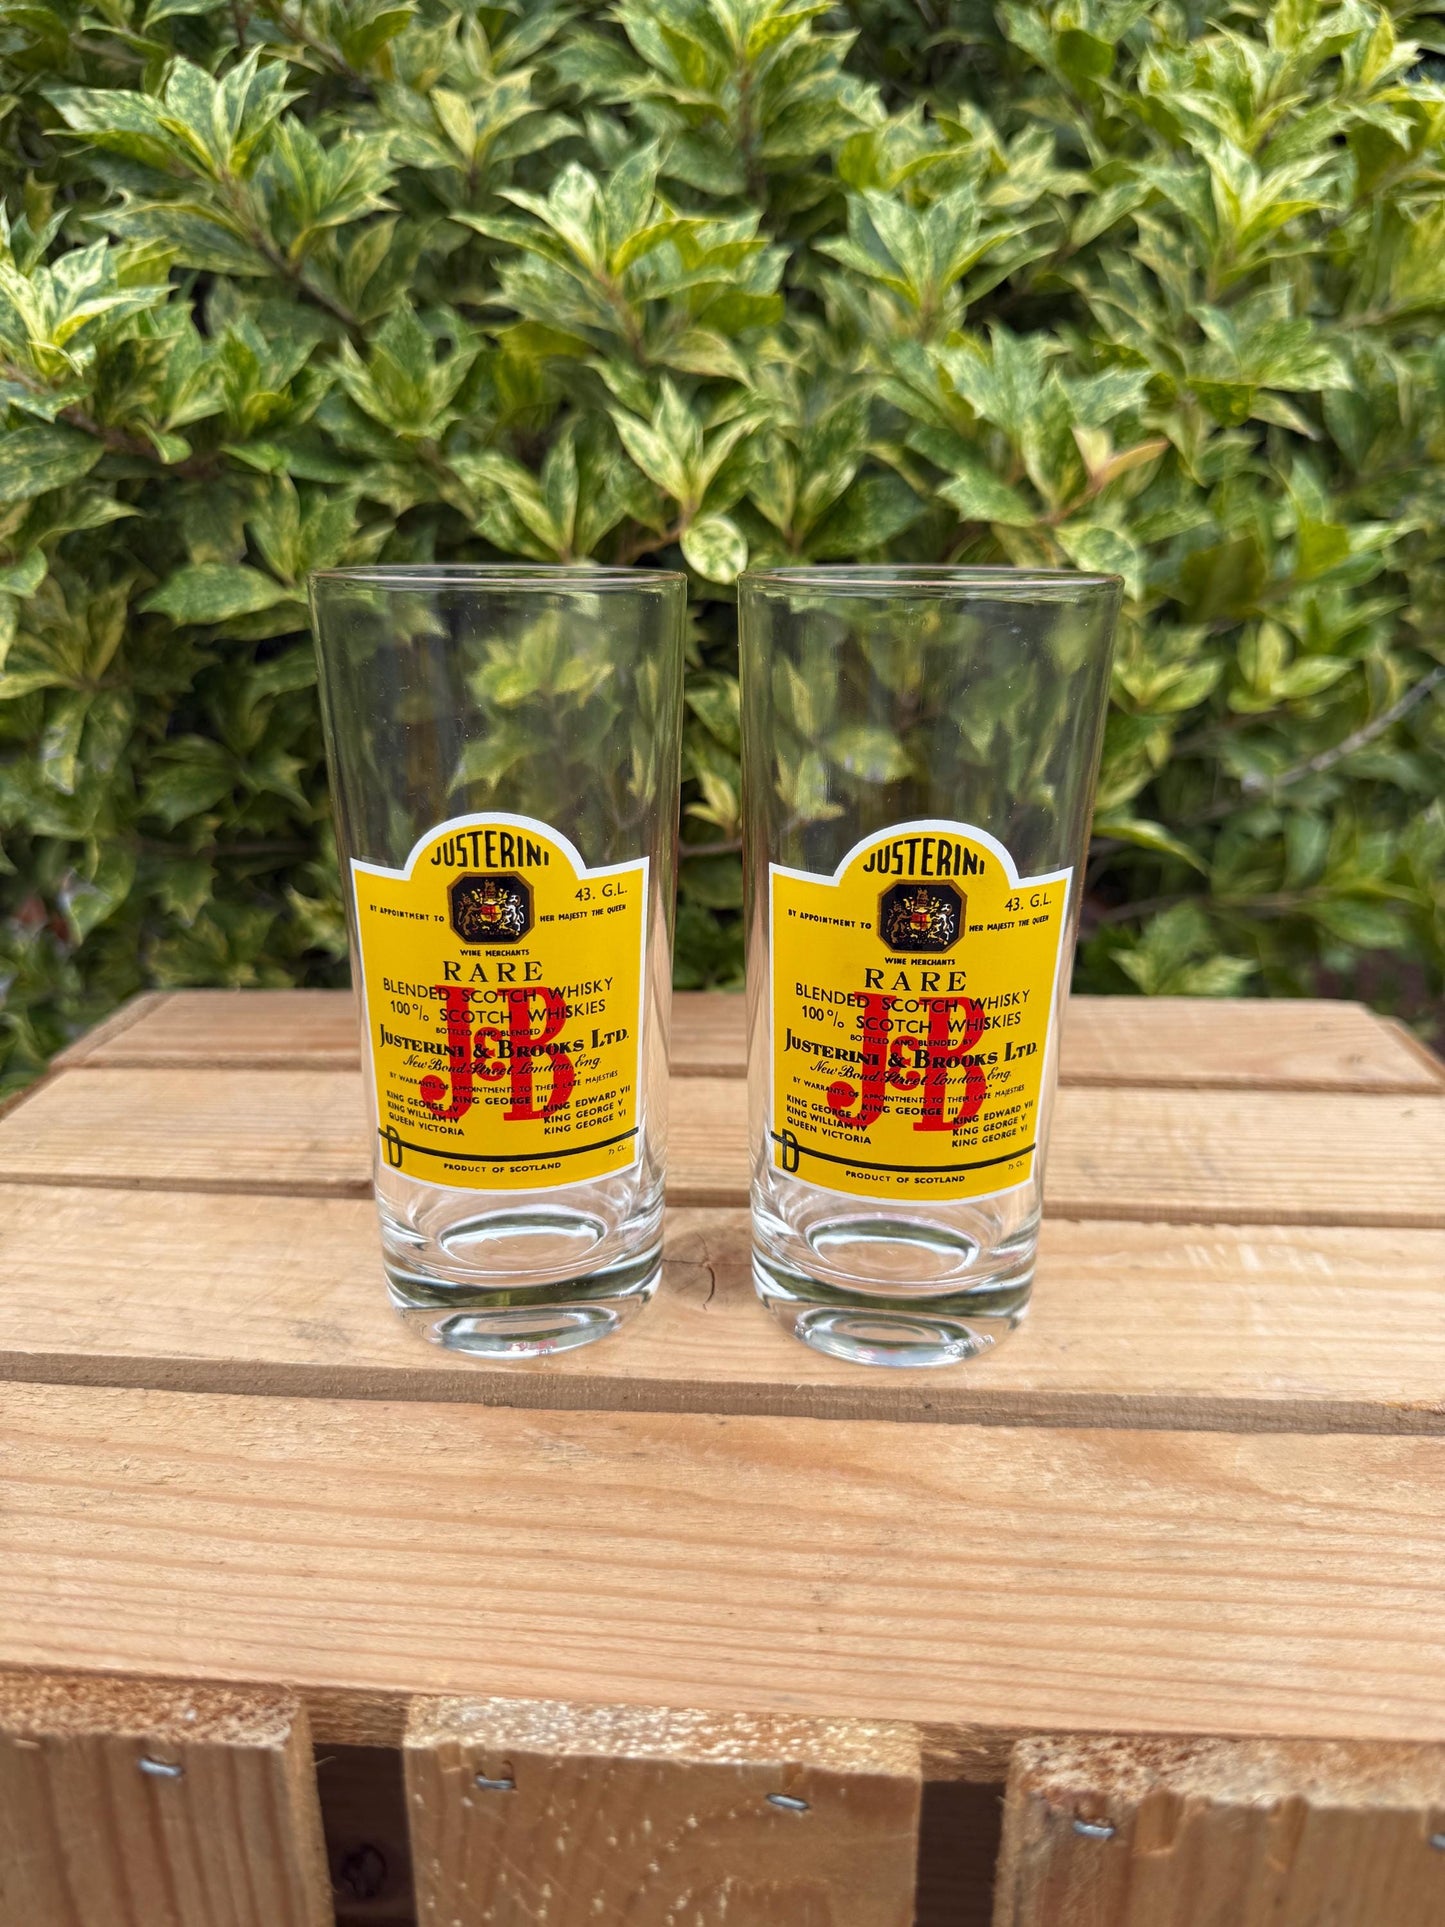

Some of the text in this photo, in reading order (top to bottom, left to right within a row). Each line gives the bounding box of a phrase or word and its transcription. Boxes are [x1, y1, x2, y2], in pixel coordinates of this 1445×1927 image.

[431, 830, 549, 868] JUSTERINI
[863, 838, 984, 876] JUSTERINI
[575, 882, 627, 901] 43. G.L.
[1004, 893, 1052, 912] 43. G.L.
[380, 907, 429, 921] APPOINTMENT
[558, 911, 588, 921] MAJESTY
[592, 908, 604, 916] THE
[607, 904, 626, 914] QUEEN
[788, 909, 872, 930] BY APPOINTMENT TO
[969, 915, 1049, 932] HER MAJESTY THE QUEEN
[460, 949, 530, 957] WINE MERCHANTS
[885, 957, 907, 965] WINE
[443, 960, 543, 983] RARE
[865, 968, 967, 992] RARE
[383, 977, 613, 1004] BLENDED SCOTCH WHISKY
[795, 982, 1031, 1013] BLENDED SCOTCH WHISKY
[439, 1008, 512, 1024] SCOTCH
[527, 999, 606, 1022] WHISKIES
[856, 1015, 932, 1033] SCOTCH
[947, 1012, 1021, 1033] WHISKIES
[380, 1023, 465, 1058] JUSTERINI
[473, 1043, 492, 1059] &
[496, 1039, 585, 1059] BROOKS
[435, 1027, 472, 1036] BOTTLED
[500, 1028, 541, 1037] BLENDED
[850, 1034, 889, 1045] BOTTLED
[784, 1027, 880, 1066] JUSTERINI
[887, 1052, 907, 1068] &
[912, 1049, 998, 1068] BROOKS
[403, 1054, 427, 1069] New
[428, 1058, 466, 1073] Bond
[467, 1061, 513, 1076] Street
[810, 1060, 838, 1075] New
[838, 1065, 880, 1081] Bond
[880, 1070, 928, 1086] Street
[398, 1074, 436, 1088] WARRANTS
[536, 1083, 558, 1091] THEIR
[562, 1080, 581, 1088] LATE
[585, 1069, 618, 1084] MAJESTIES
[804, 1080, 845, 1096] WARRANTS
[948, 1095, 970, 1103] THEIR
[974, 1093, 991, 1101] LATE
[995, 1084, 1025, 1097] MAJESTIES
[386, 1090, 459, 1113] KING GEORGE IV
[452, 1095, 547, 1105] KING GEORGE III
[543, 1085, 631, 1113] KING EDWARD VII
[786, 1094, 867, 1121] KING GEORGE IV
[862, 1103, 958, 1115] KING GEORGE III
[387, 1101, 460, 1124] KING WILLIAM IV
[543, 1098, 624, 1124] KING GEORGE V
[544, 1109, 627, 1135] KING GEORGE VI
[786, 1105, 868, 1132] KING WILLIAM IV
[953, 1100, 1033, 1125] KING EDWARD VII
[389, 1112, 465, 1136] QUEEN VICTORIA
[787, 1116, 872, 1144] QUEEN VICTORIA
[952, 1113, 1027, 1136] KING GEORGE V
[951, 1124, 1028, 1148] KING GEORGE VI
[444, 1163, 486, 1173] PRODUCT
[510, 1162, 561, 1173] SCOTLAND
[845, 1170, 965, 1184] PRODUCT OF SCOTLAND
